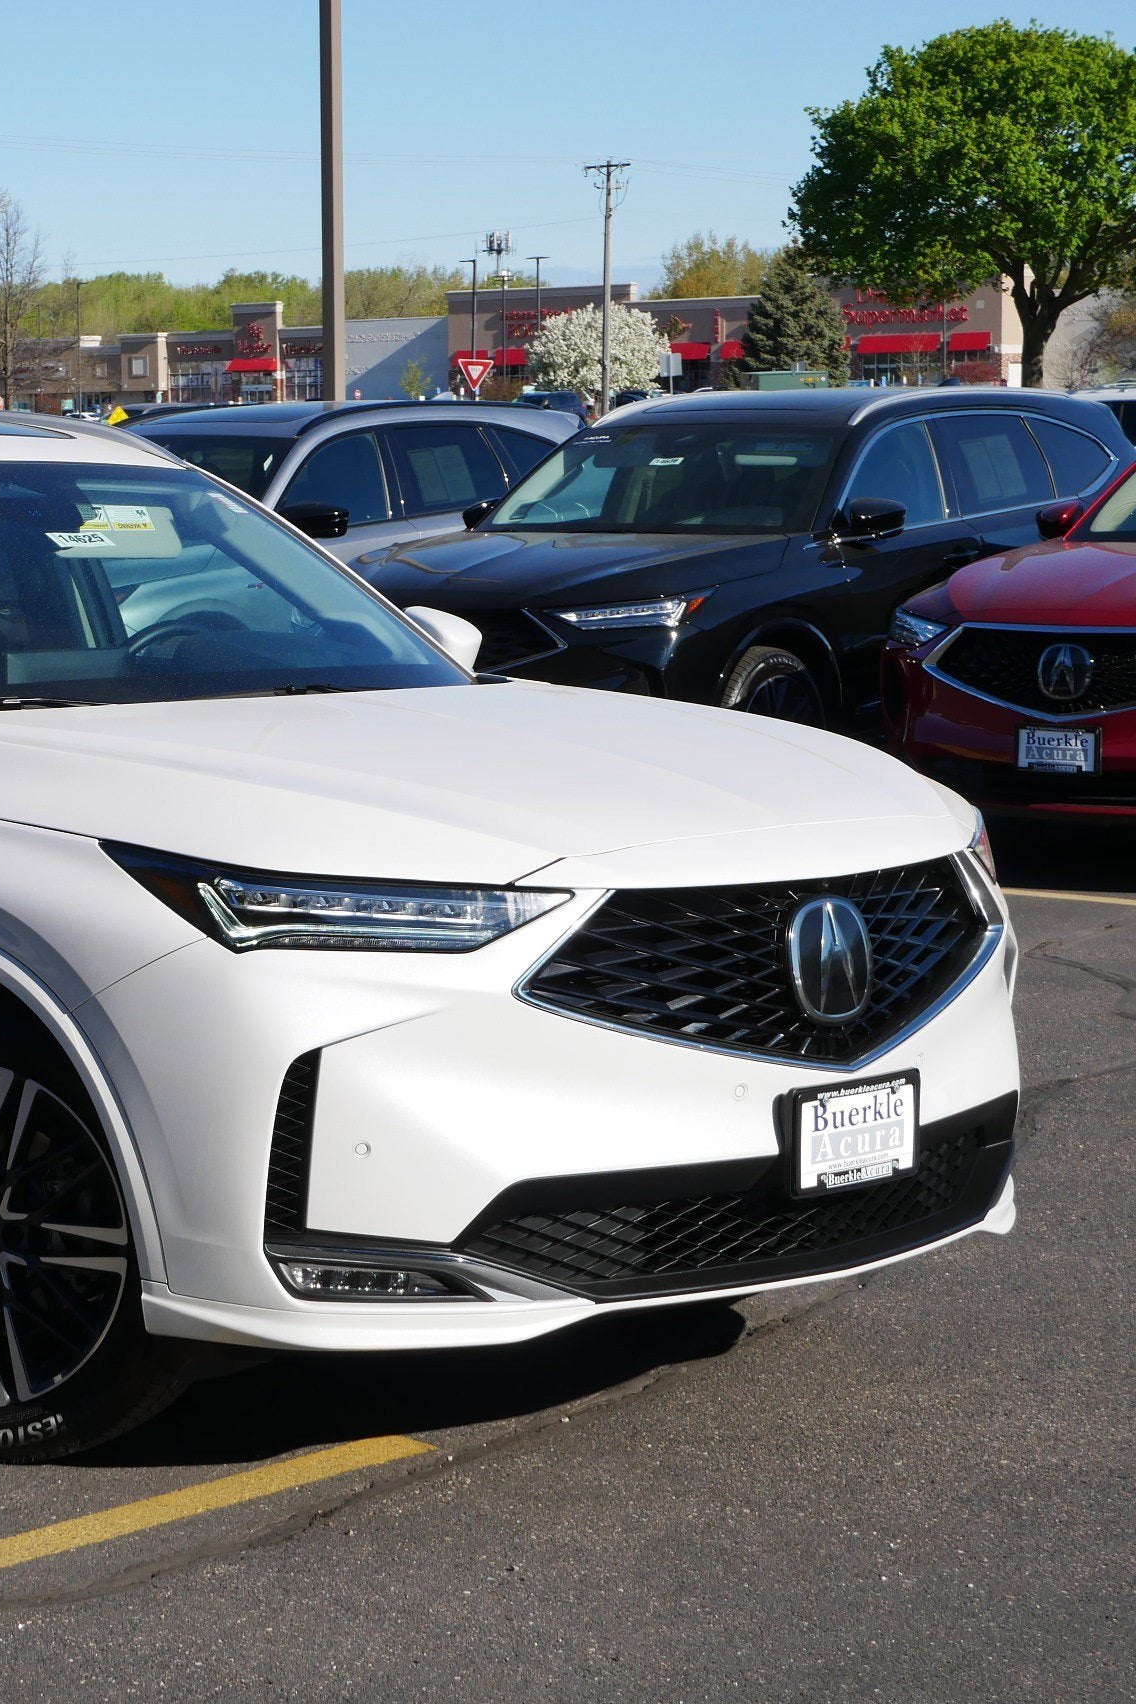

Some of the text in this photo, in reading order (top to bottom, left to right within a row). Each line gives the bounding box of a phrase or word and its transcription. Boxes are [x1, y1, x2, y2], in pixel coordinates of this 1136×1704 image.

[843, 303, 968, 329] Supermarket
[58, 533, 105, 544] 14625
[1026, 731, 1089, 748] Buerkle
[1028, 746, 1085, 761] Acura
[817, 1078, 906, 1100] www.buerkleacura.com
[812, 1092, 904, 1132] Buerkle
[815, 1126, 901, 1161] Acura
